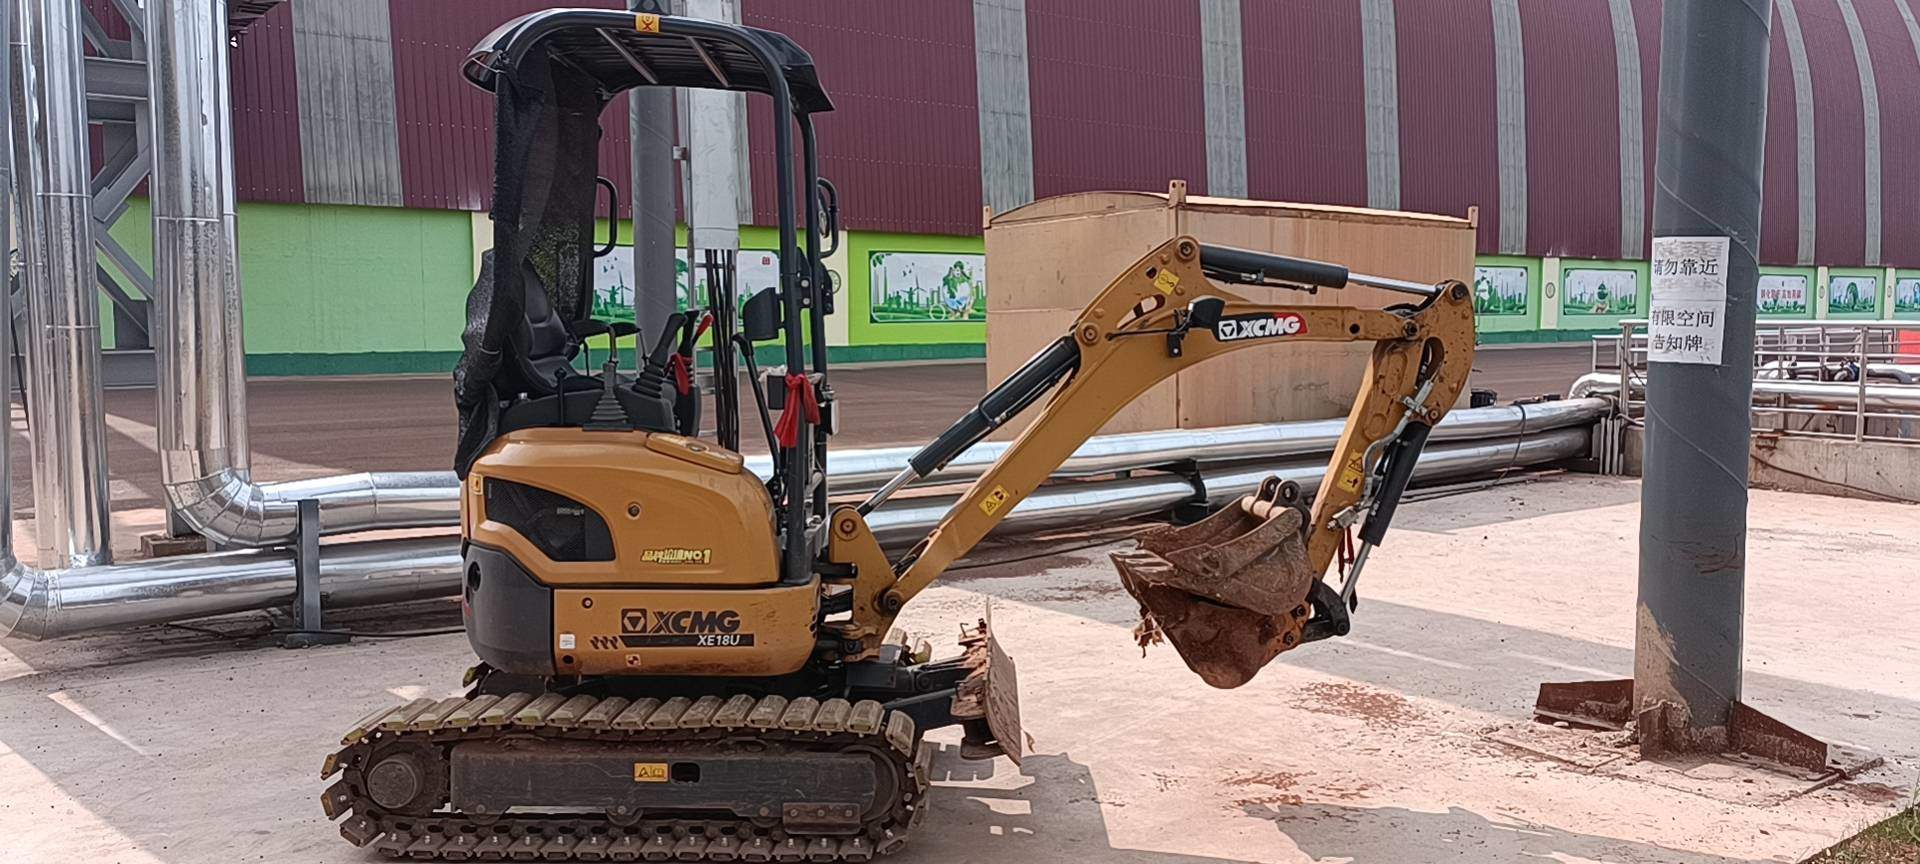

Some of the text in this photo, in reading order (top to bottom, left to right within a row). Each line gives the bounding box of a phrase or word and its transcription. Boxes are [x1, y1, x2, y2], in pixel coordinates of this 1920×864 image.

[1653, 258, 1719, 276] 请勿靠近
[1238, 316, 1301, 338] XCMG
[1651, 310, 1715, 328] 有限空间
[1653, 334, 1703, 352] 告知牌
[649, 610, 741, 634] XCMG
[697, 635, 740, 646] XE18U
